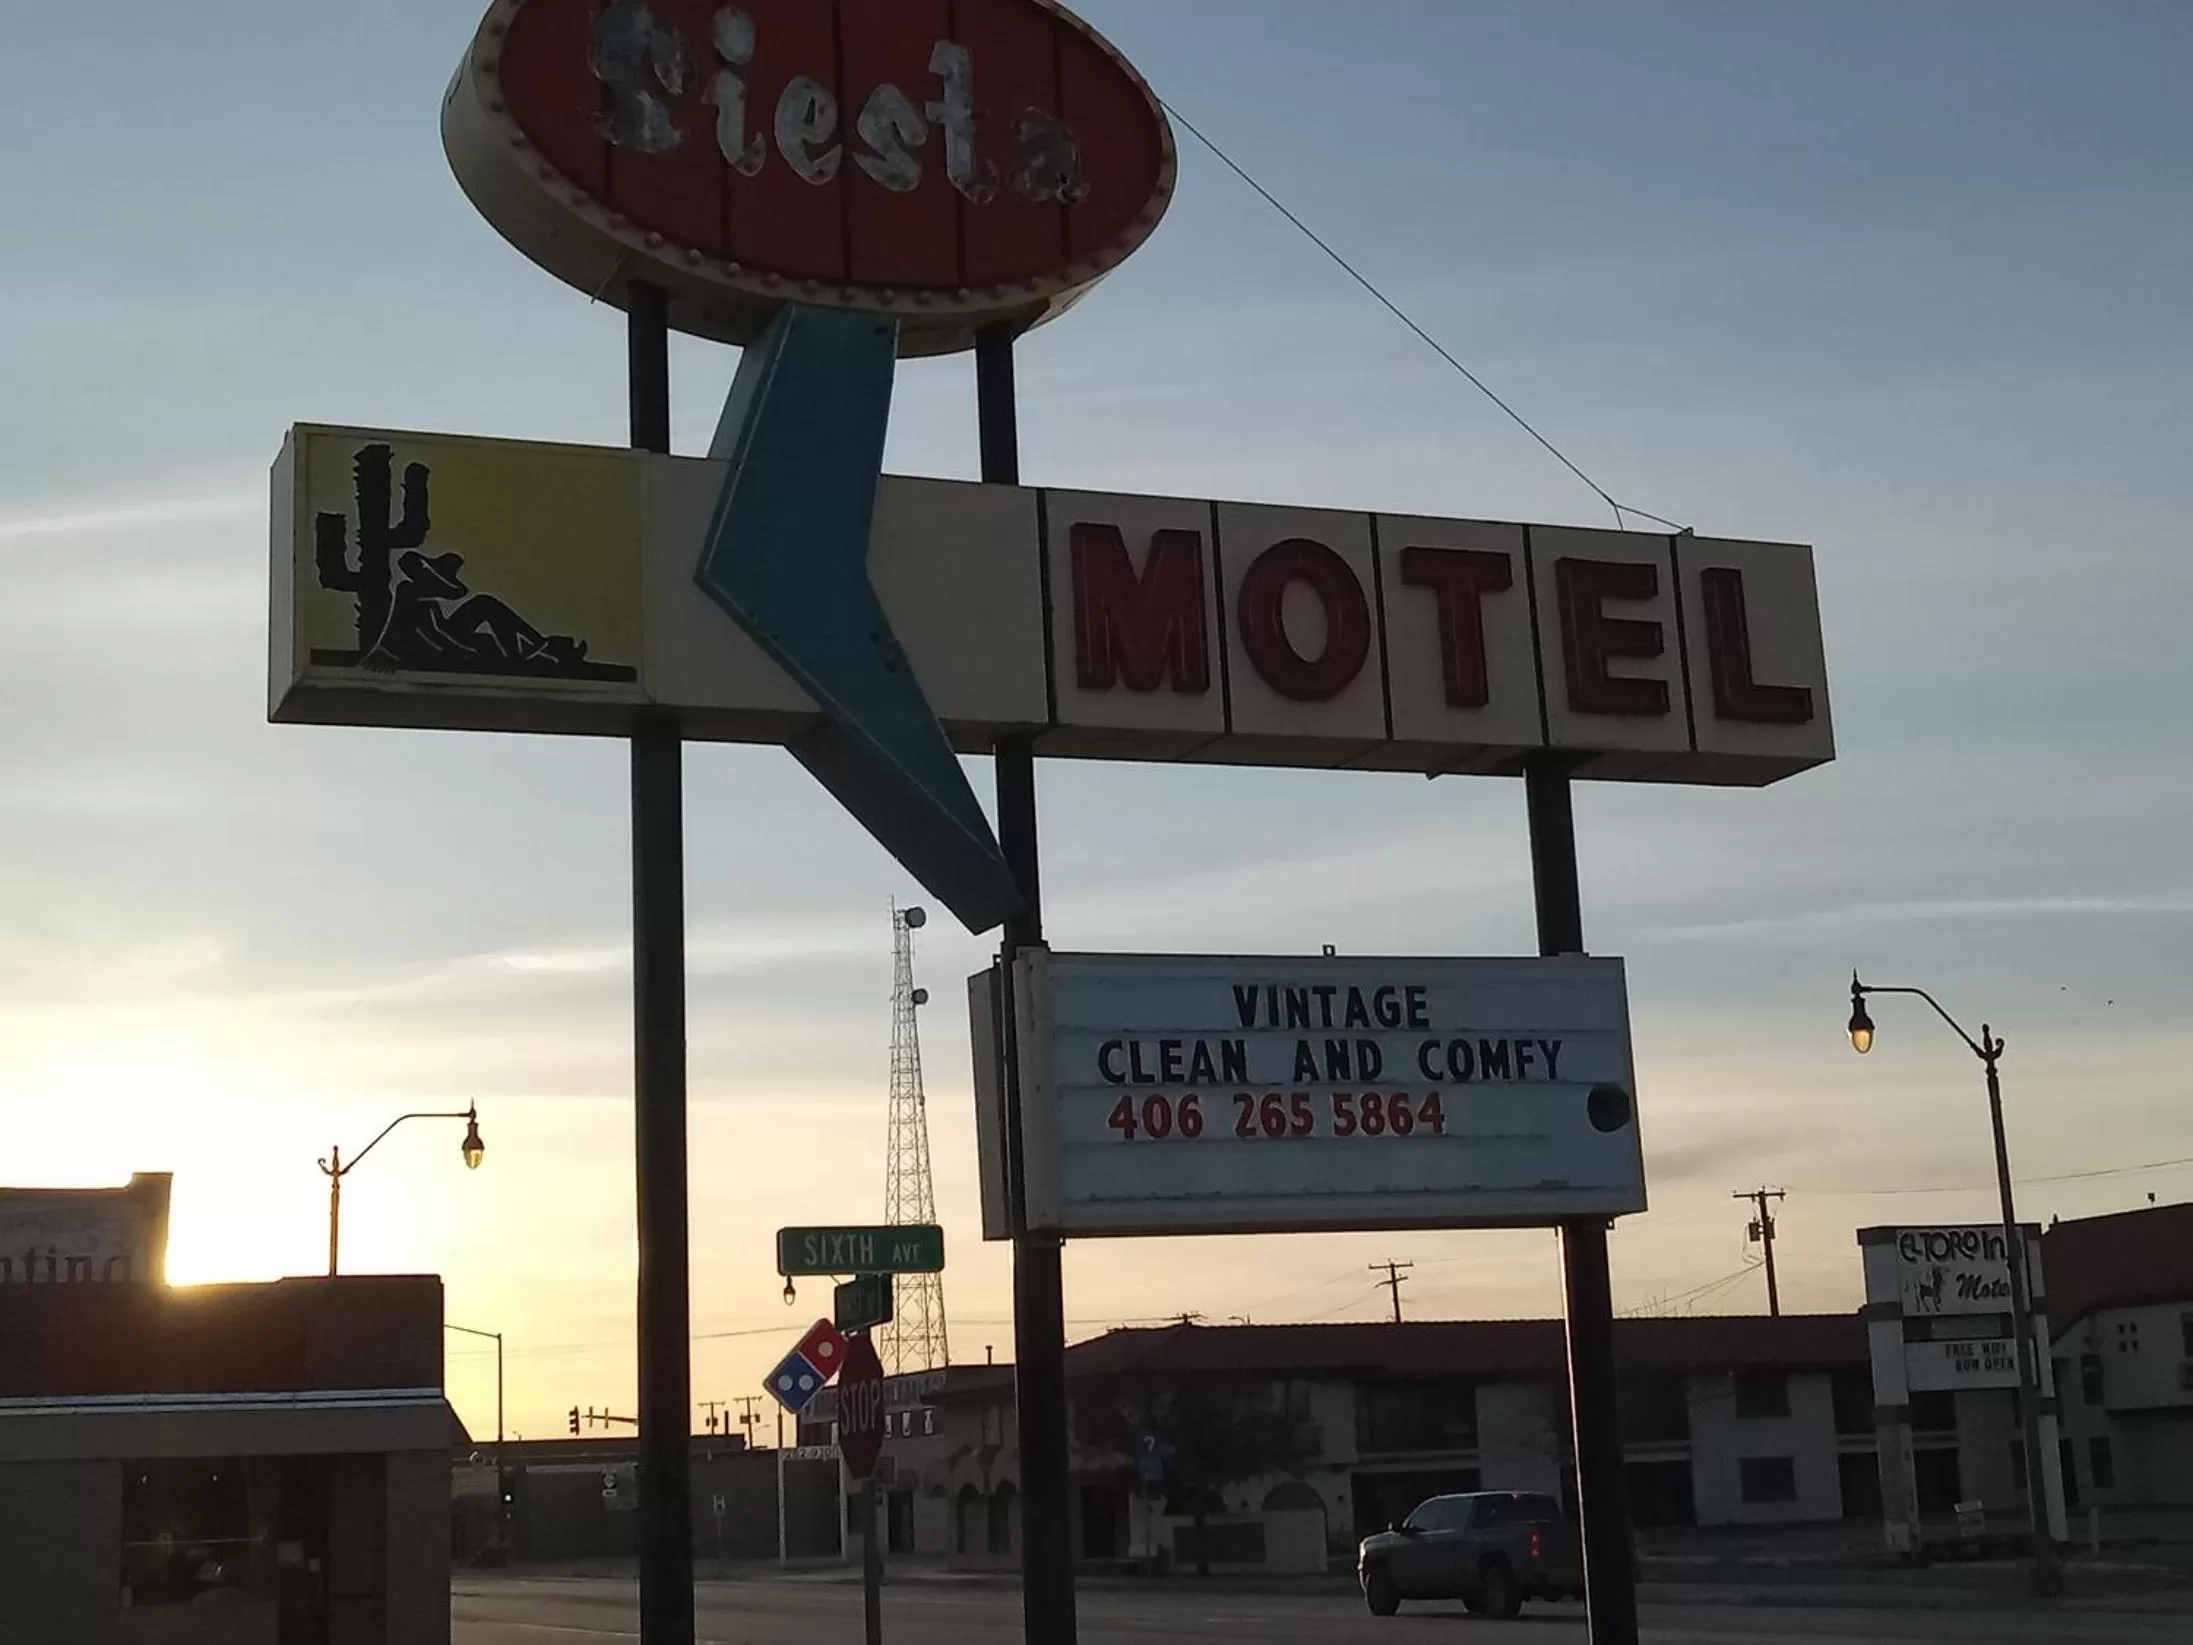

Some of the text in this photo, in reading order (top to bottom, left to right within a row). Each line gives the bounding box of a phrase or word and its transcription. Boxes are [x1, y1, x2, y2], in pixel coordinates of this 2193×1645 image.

[1070, 522, 1815, 725] MOTEL
[1232, 985, 1431, 1030] VINTAGE
[1097, 1038, 1563, 1087] CLEAN AND COMFY
[1107, 1091, 1446, 1140] 406 265 5864
[804, 1234, 920, 1266] SIXTH AVE
[841, 1378, 881, 1436] STOP
